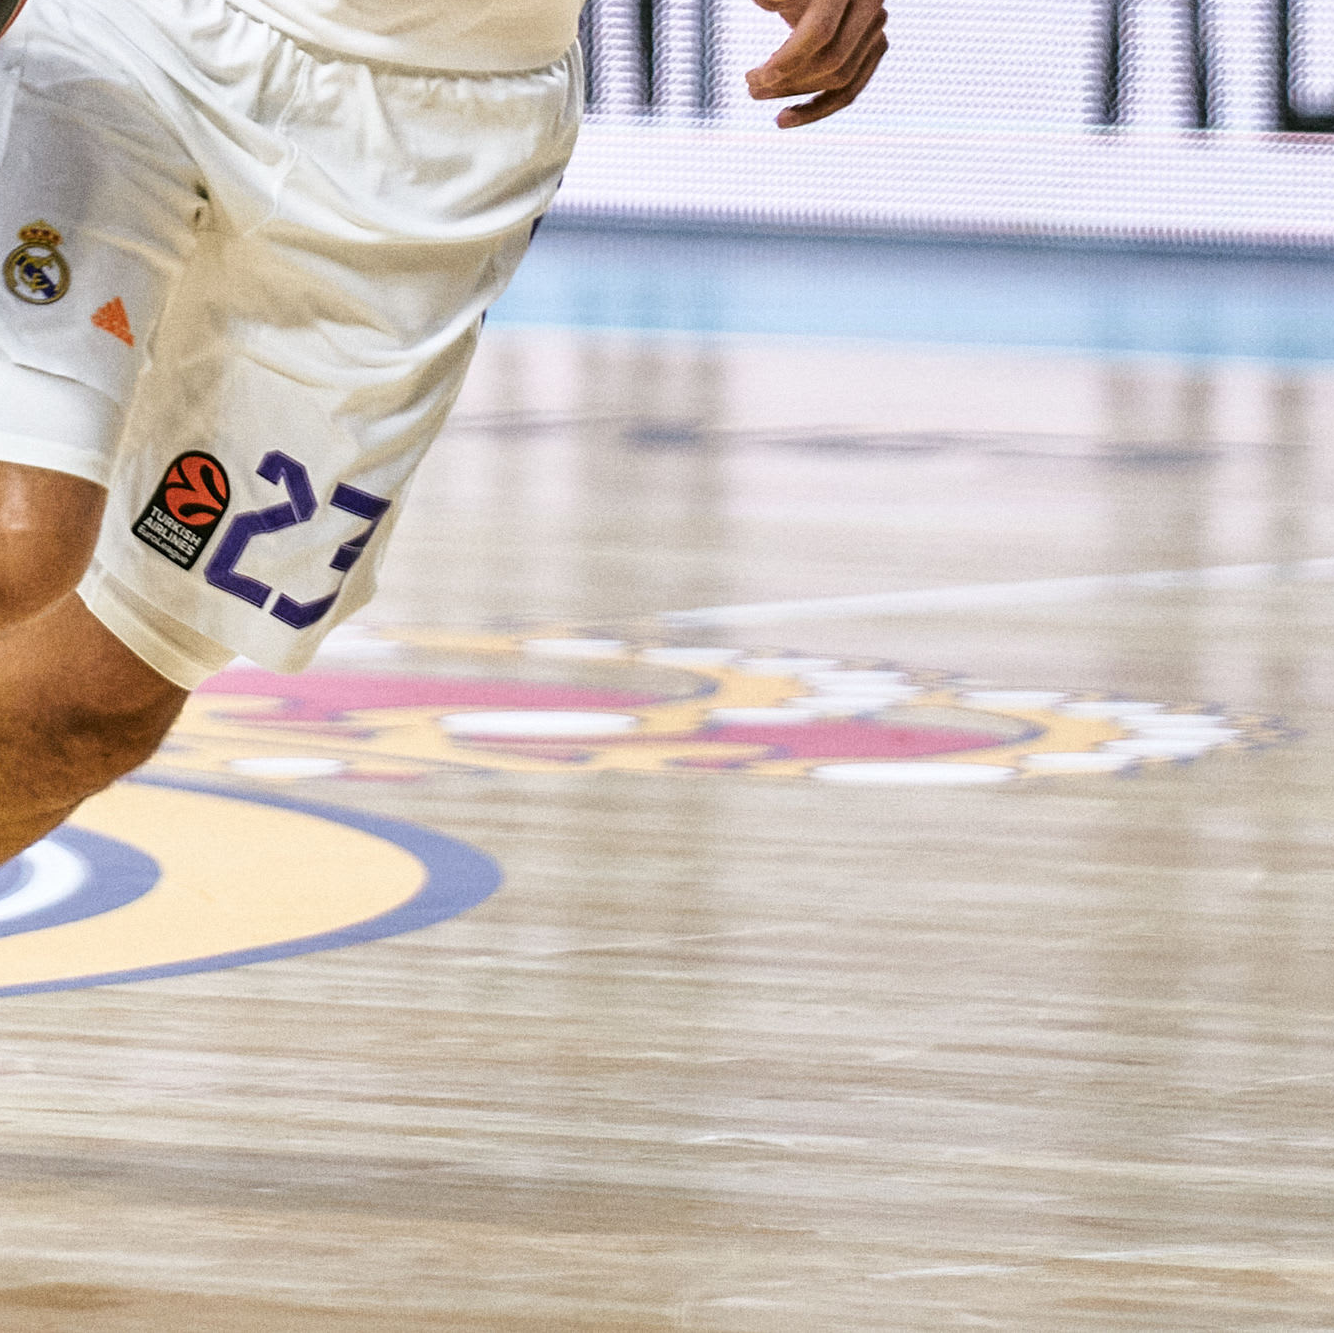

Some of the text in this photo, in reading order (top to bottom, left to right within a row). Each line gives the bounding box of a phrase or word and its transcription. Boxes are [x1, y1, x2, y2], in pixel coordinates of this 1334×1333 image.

[142, 516, 197, 557] AIRLINES
[149, 505, 203, 549] TURKISH
[203, 449, 392, 630] 23
